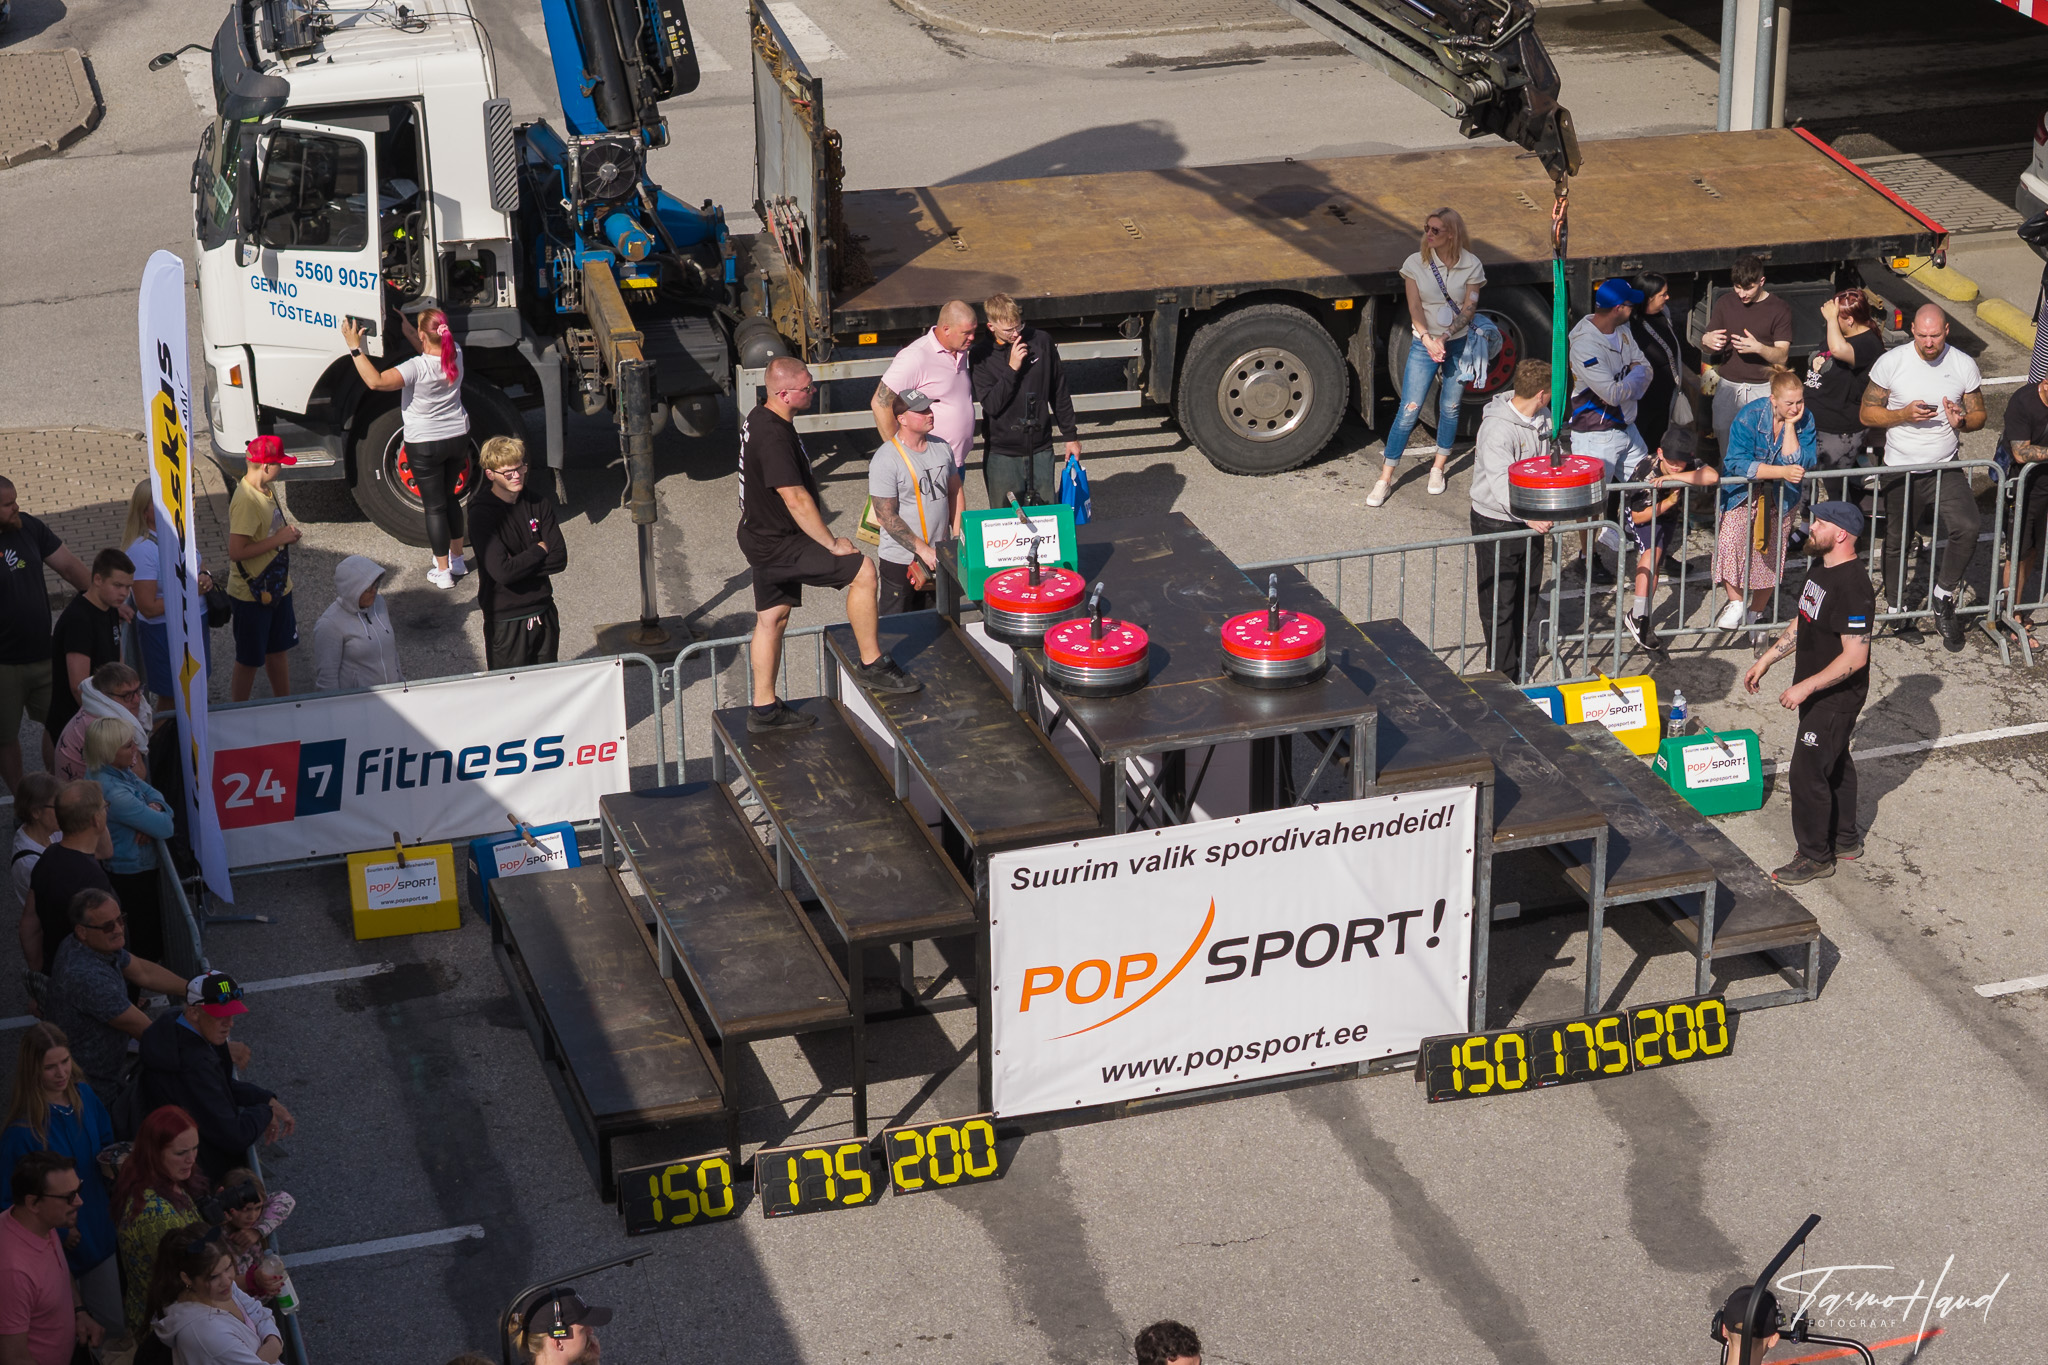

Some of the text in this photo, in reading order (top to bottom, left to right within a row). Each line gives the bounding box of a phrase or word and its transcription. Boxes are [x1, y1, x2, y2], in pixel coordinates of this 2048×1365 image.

[250, 276, 298, 298] GENNO
[296, 260, 378, 290] 5560 9057
[269, 300, 337, 329] TÕSTEABI
[986, 539, 1008, 548] POP
[1586, 703, 1642, 718] POP SPORT!
[1687, 756, 1746, 772] POP SPORT!
[222, 768, 286, 809] 24
[308, 764, 334, 798] 7
[500, 850, 563, 872] POP SPORT!
[1010, 804, 1456, 891] Suurim valik spordivahendeid!
[369, 876, 436, 893] POP SPORT!
[1019, 898, 1447, 1013] POP SPORT!
[1101, 1023, 1368, 1083] www.popsport.ee
[1452, 1000, 1728, 1093] 150 175 200
[648, 1120, 998, 1225] 150 175 200
